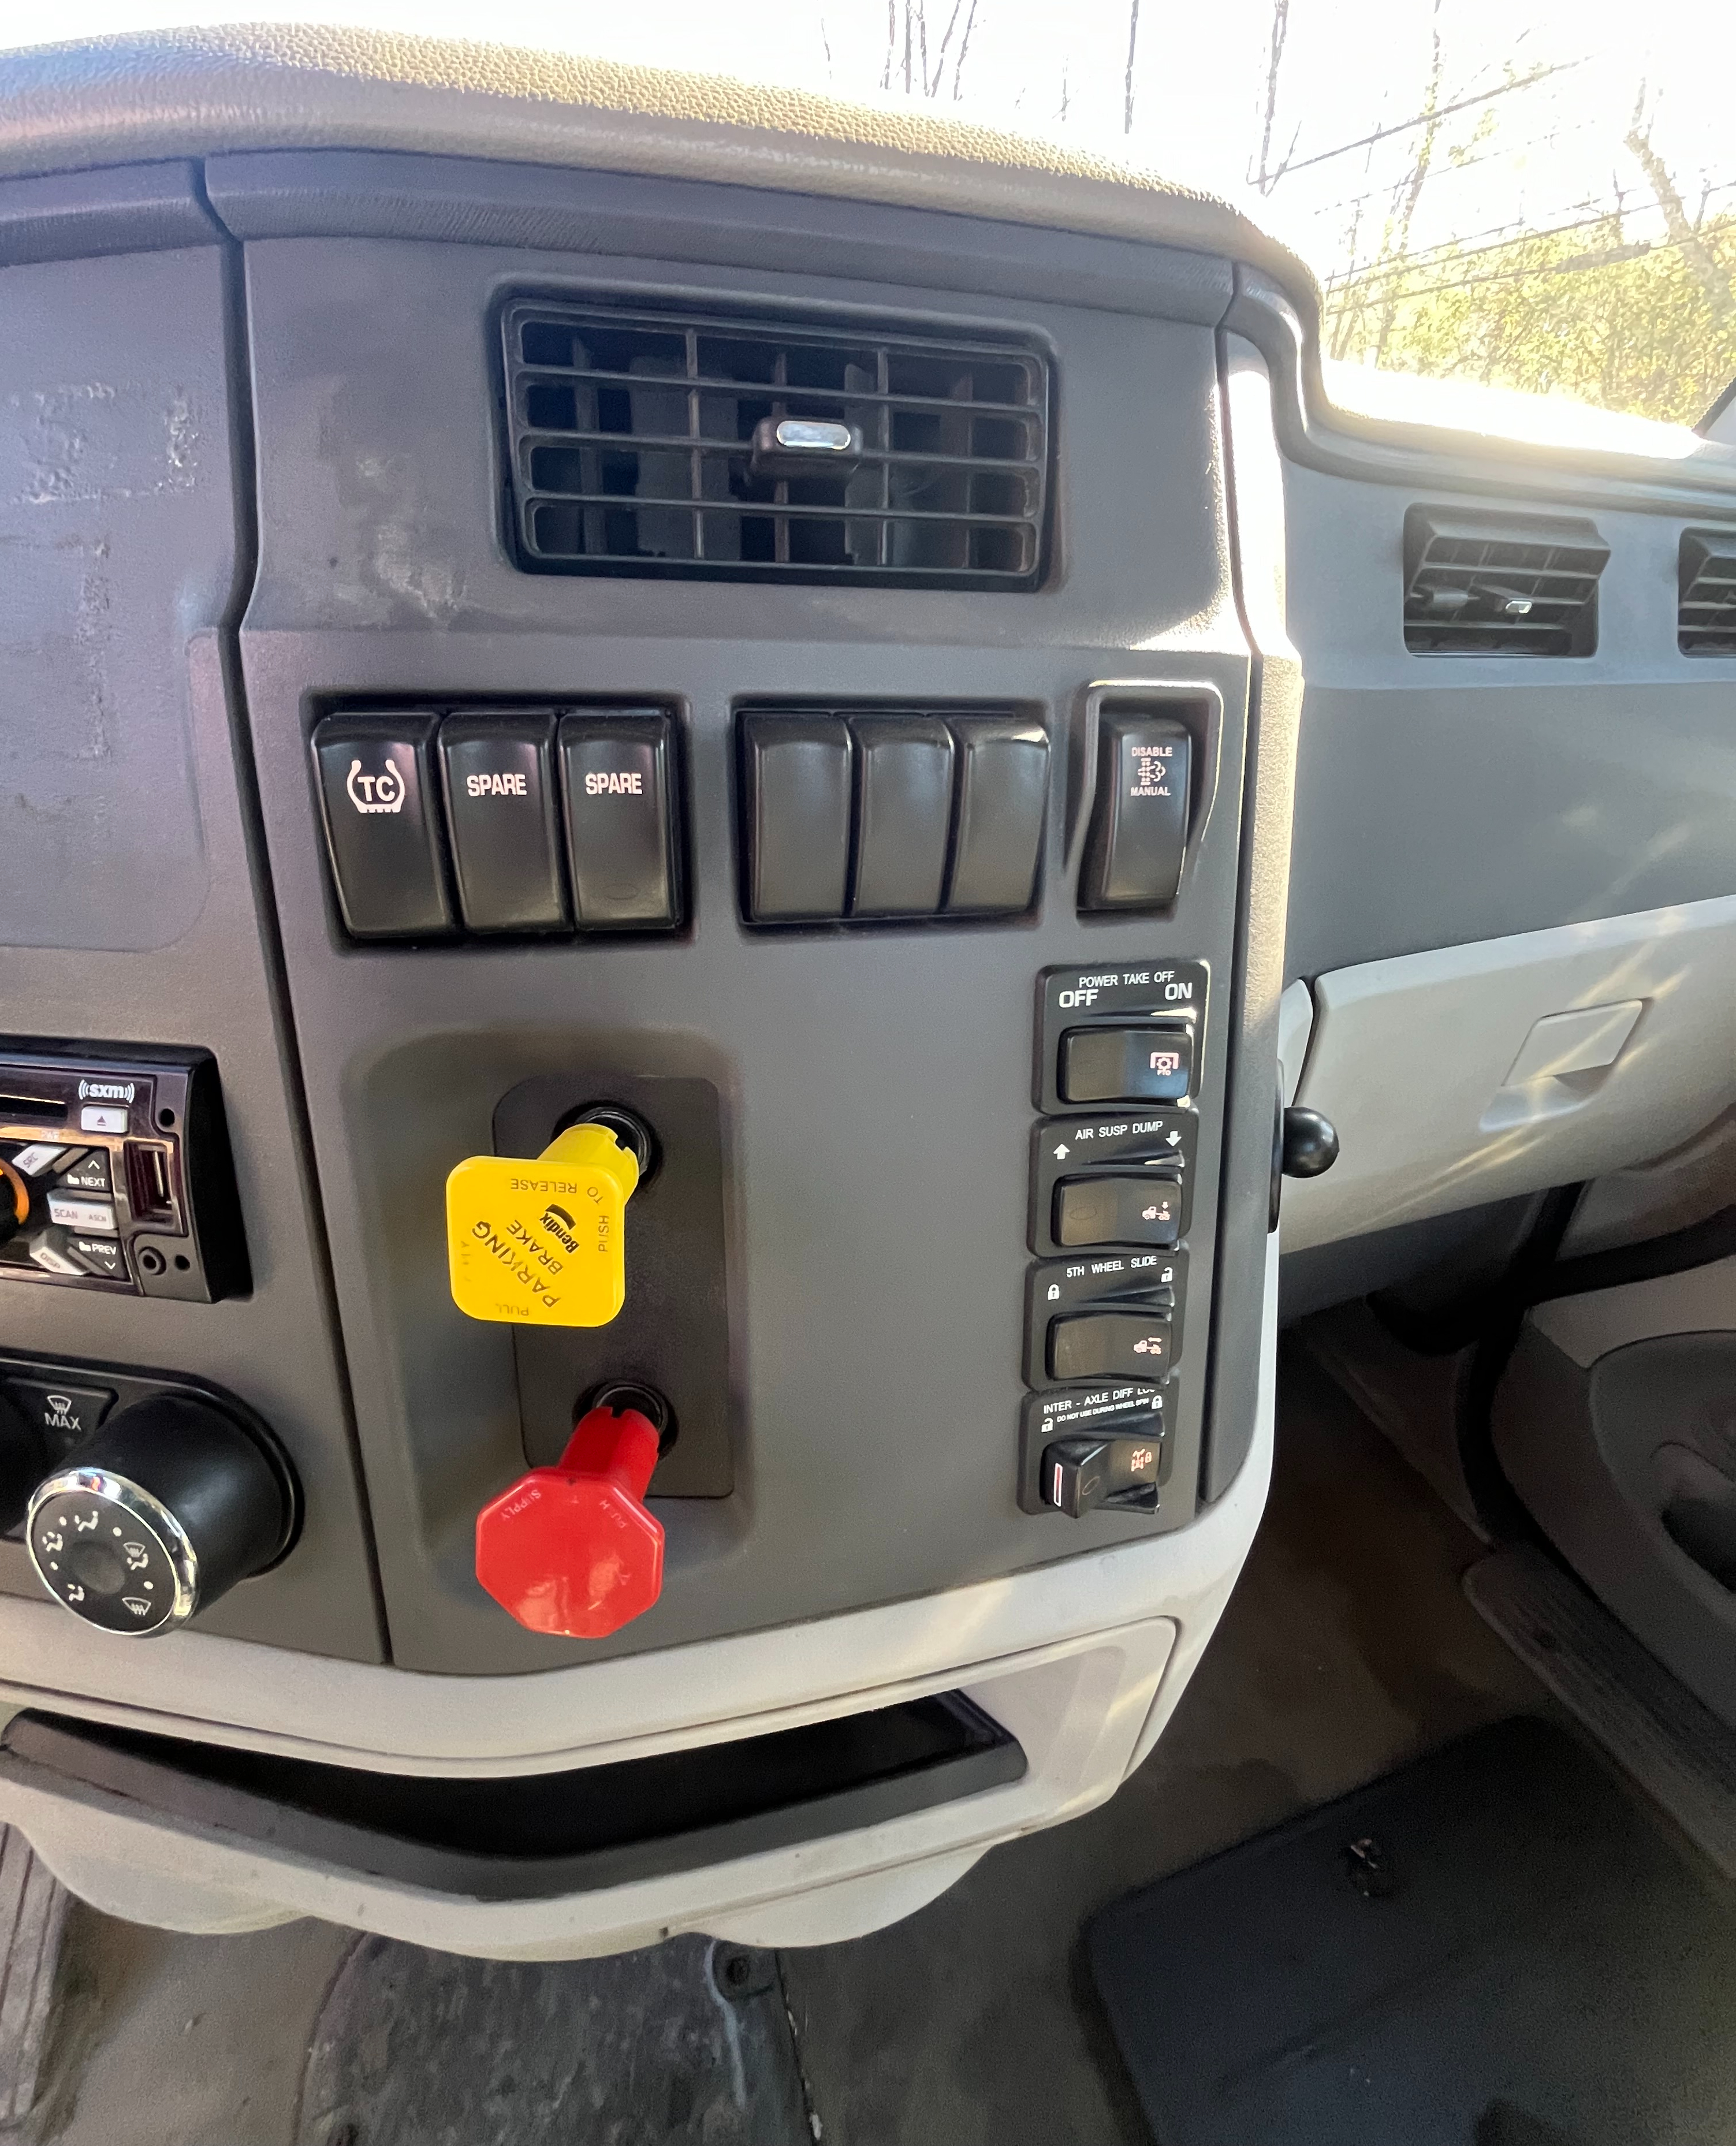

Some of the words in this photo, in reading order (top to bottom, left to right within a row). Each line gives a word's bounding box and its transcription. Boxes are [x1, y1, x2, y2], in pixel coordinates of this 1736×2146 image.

[1131, 747, 1173, 757] DISABLE
[357, 776, 396, 802] TC
[467, 774, 527, 796] SPARE
[585, 773, 643, 795] SPARE
[1130, 787, 1171, 796] MANUAL
[1079, 975, 1118, 988] POWER
[1123, 973, 1149, 985] TAKE
[1154, 971, 1175, 983] OFF
[1059, 989, 1099, 1008] OFF
[1164, 982, 1193, 1000] ON
[1075, 1129, 1094, 1140] AIR
[1098, 1125, 1128, 1138] SUSP
[1133, 1121, 1163, 1134] DUMP
[81, 1176, 105, 1187] NEXT
[511, 1178, 578, 1194] RELEASE
[587, 1187, 603, 1205] TO
[54, 1208, 78, 1219] SCAN
[539, 1213, 579, 1253] Bendix
[598, 1215, 610, 1252] PUSH
[92, 1243, 116, 1255] PREV
[506, 1219, 564, 1275] BRAKE
[472, 1221, 561, 1307] PARKING
[1066, 1266, 1085, 1277] 5TH
[1091, 1260, 1124, 1273] WHEEL
[1131, 1255, 1157, 1268] SLIDE
[1044, 1400, 1072, 1414] INTER
[1084, 1392, 1109, 1406] AXLE
[1113, 1388, 1133, 1400] DIFF
[1067, 1412, 1079, 1420] NOT
[1080, 1409, 1092, 1417] USE
[1093, 1404, 1115, 1415] DURING
[1115, 1400, 1135, 1410] WHEEL
[1135, 1398, 1149, 1406] SPIN
[44, 1413, 81, 1431] MAX
[599, 1500, 627, 1528] PUH
